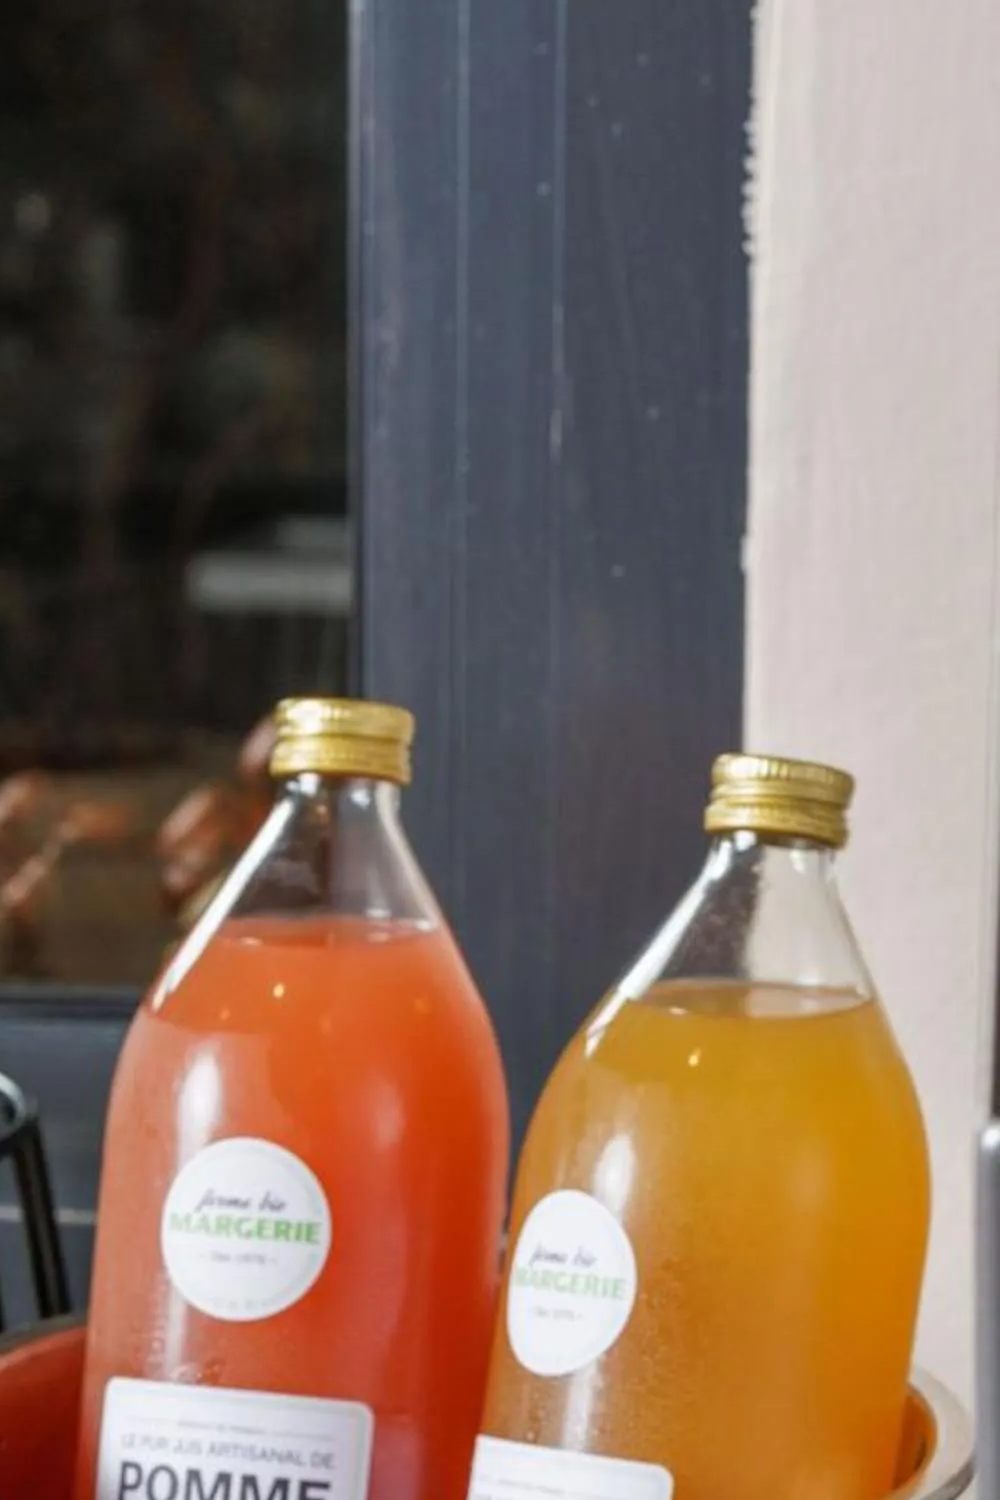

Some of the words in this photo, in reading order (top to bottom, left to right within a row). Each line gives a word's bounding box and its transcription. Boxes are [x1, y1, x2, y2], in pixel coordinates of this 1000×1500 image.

[170, 1212, 322, 1245] MARGERIE
[208, 1441, 305, 1468] ARTISANAL
[309, 1451, 336, 1470] DE
